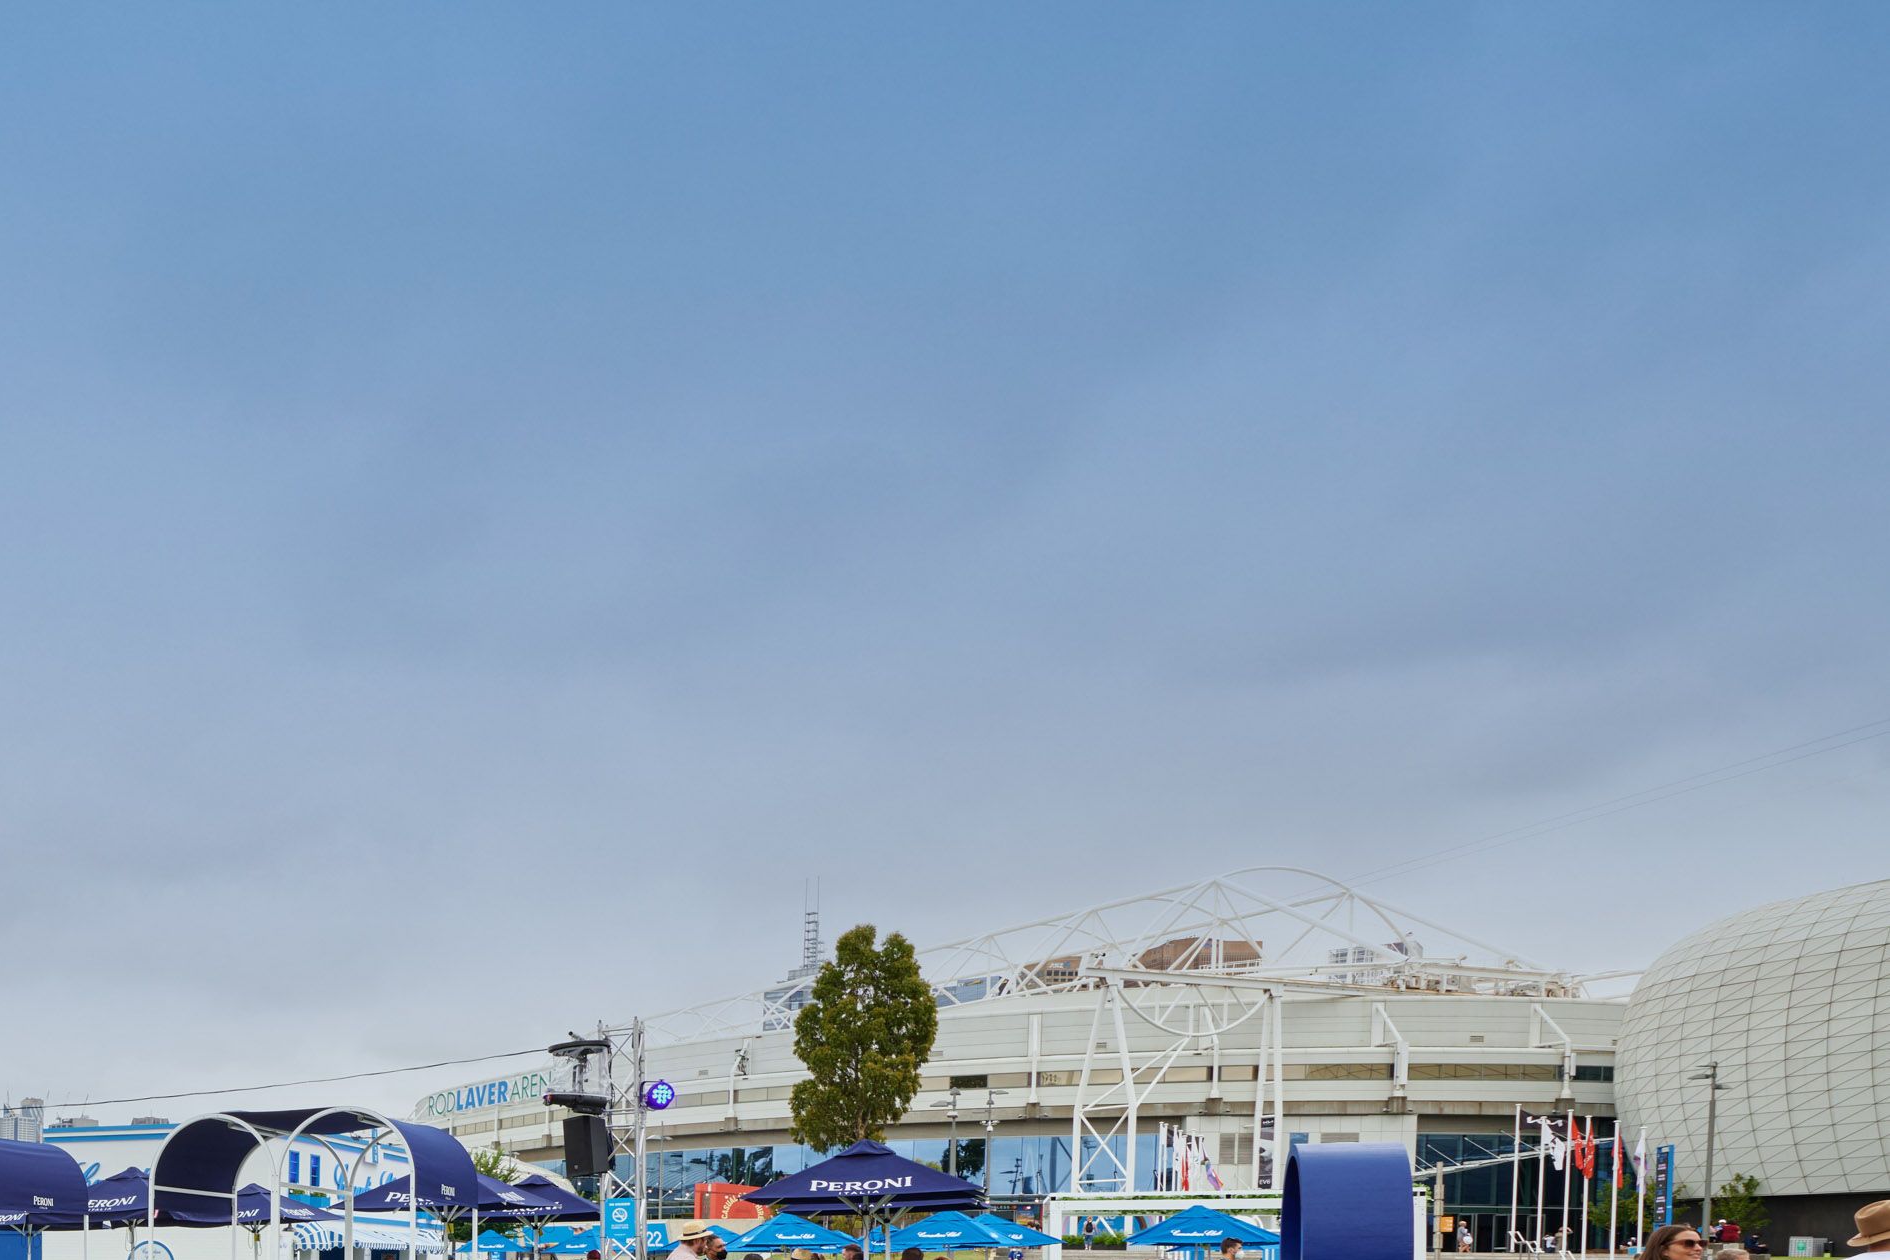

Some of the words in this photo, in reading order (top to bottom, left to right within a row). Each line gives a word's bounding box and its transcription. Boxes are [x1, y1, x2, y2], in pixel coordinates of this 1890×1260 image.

[510, 1071, 552, 1100] AREN
[810, 1176, 912, 1191] PERONI
[441, 1184, 456, 1197] PERONI
[33, 1196, 54, 1207] PERONI
[88, 1195, 137, 1208] ERONI
